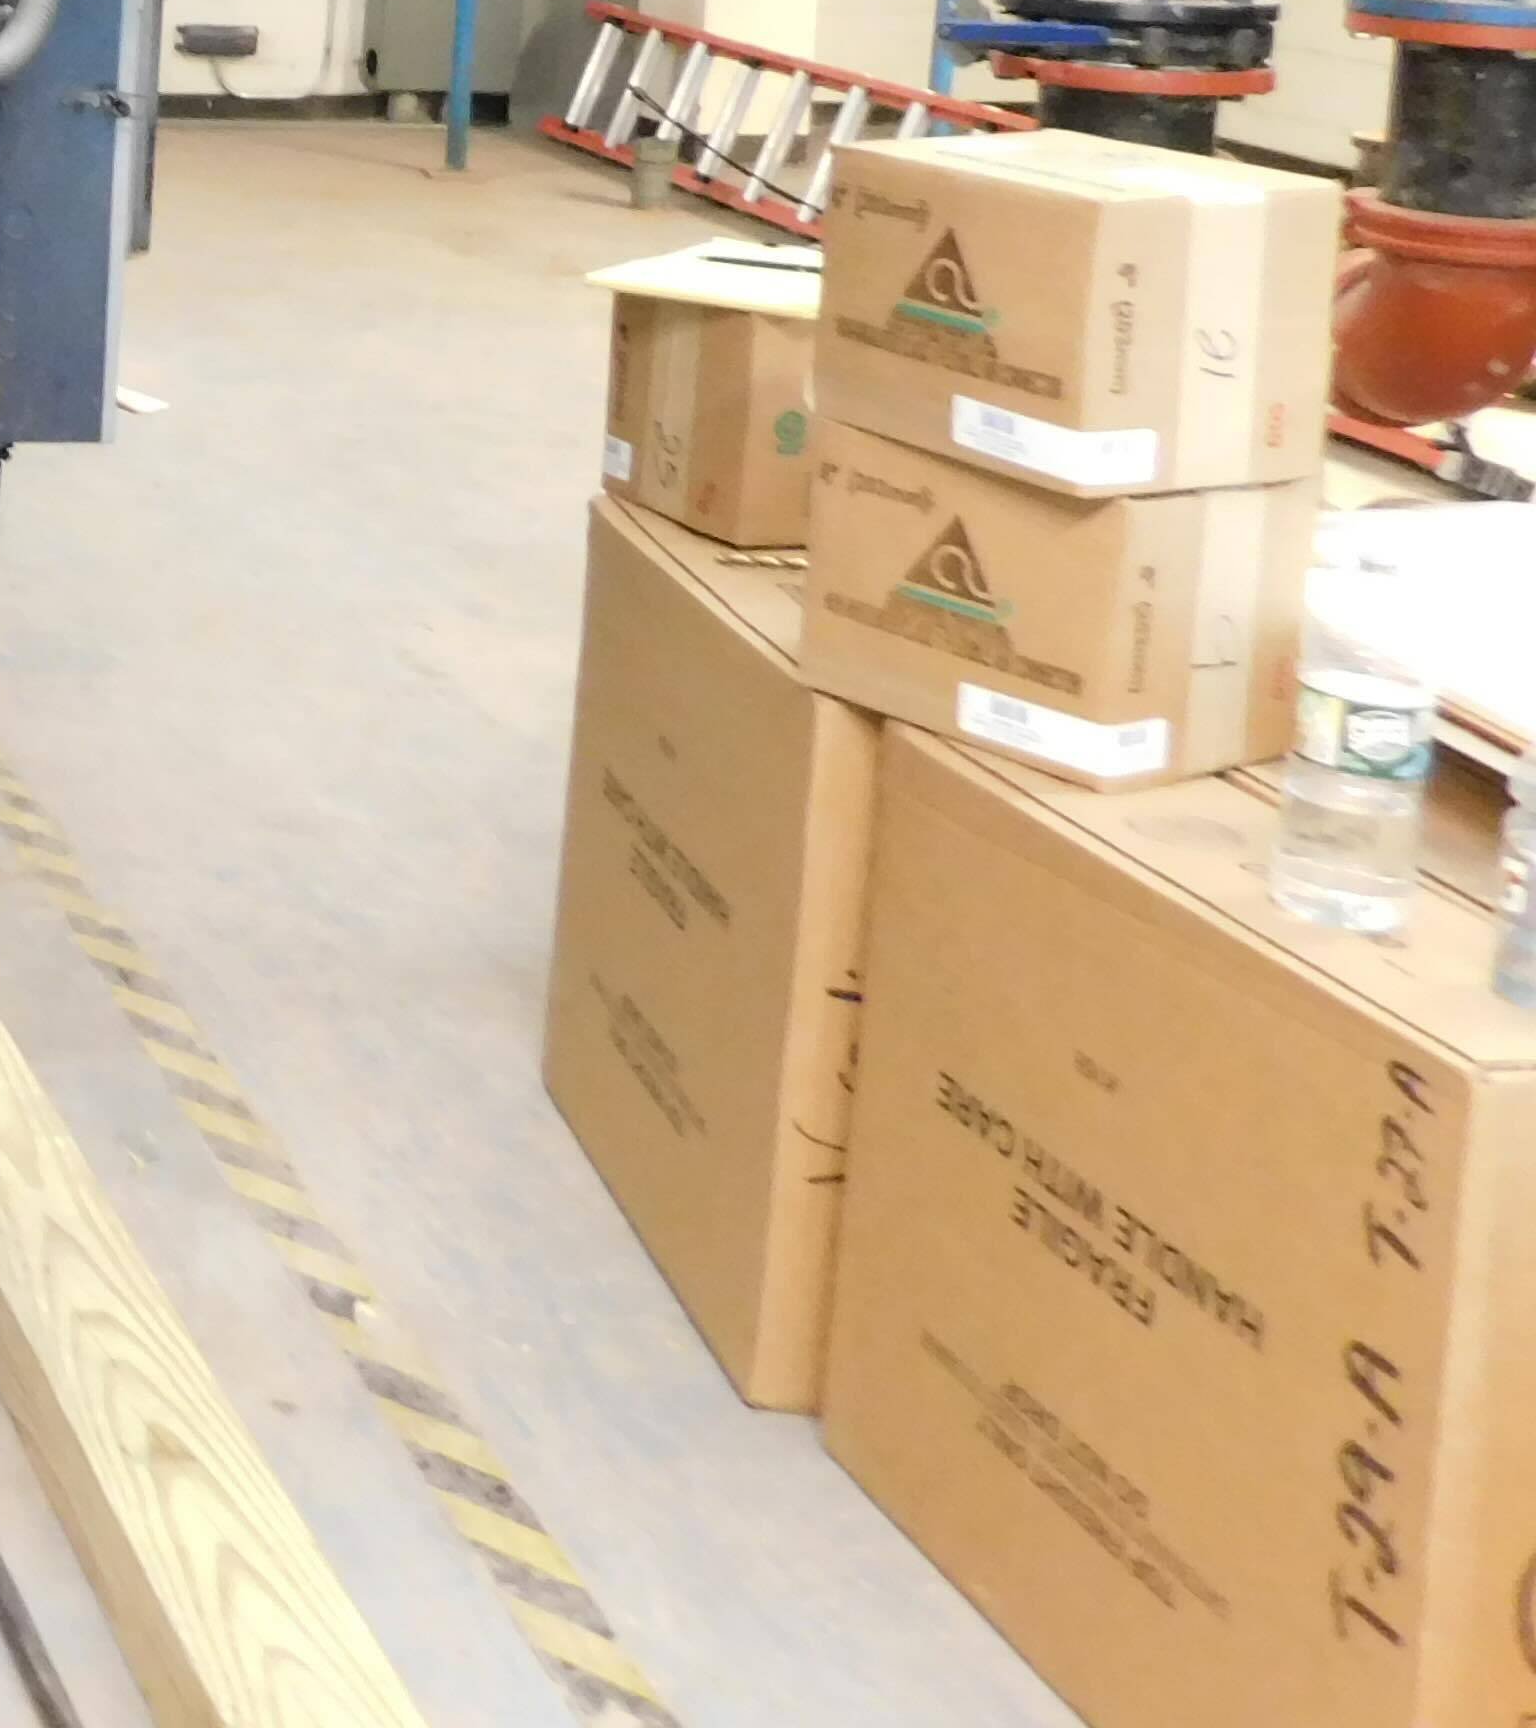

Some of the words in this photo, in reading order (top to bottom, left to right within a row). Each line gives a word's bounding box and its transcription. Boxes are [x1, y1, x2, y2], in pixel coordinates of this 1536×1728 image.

[936, 1070, 1016, 1159] CARE
[1023, 1138, 1104, 1232] WITH
[1009, 1185, 1157, 1329] FRAGILE
[1114, 1204, 1264, 1350] HANDLE
